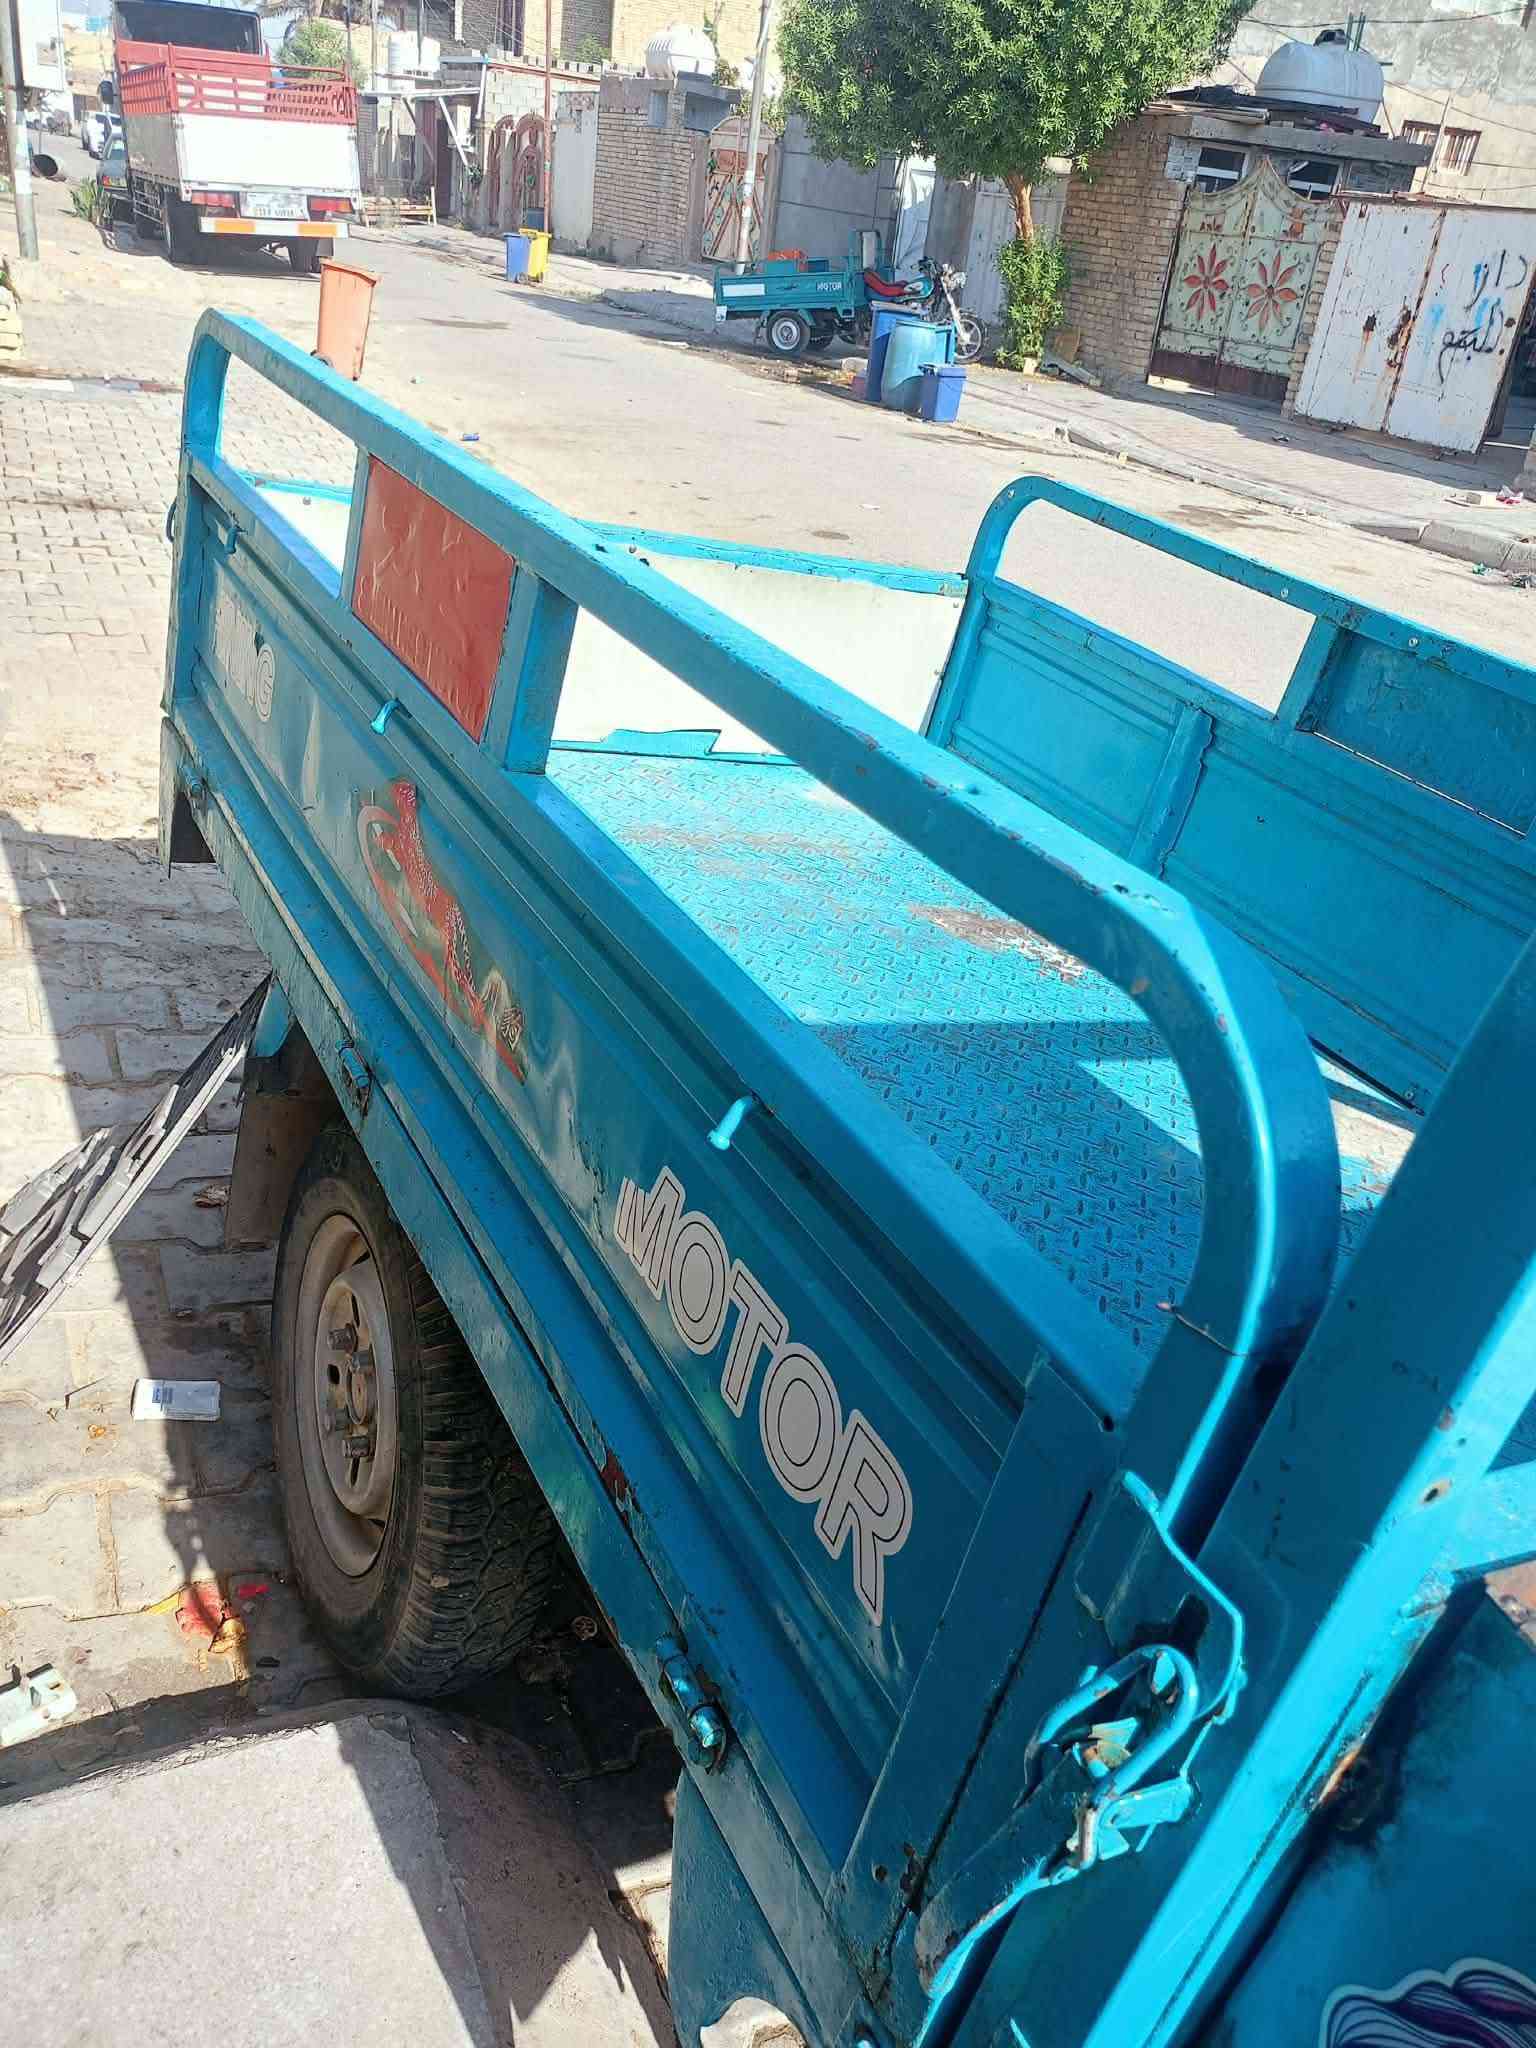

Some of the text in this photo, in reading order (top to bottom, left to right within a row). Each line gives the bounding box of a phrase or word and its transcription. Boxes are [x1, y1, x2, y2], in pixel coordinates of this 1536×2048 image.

[817, 281, 842, 292] MOTOR
[1464, 249, 1527, 312] دار
[1438, 297, 1504, 384] للبيع
[615, 1166, 911, 1622] MOTOR
